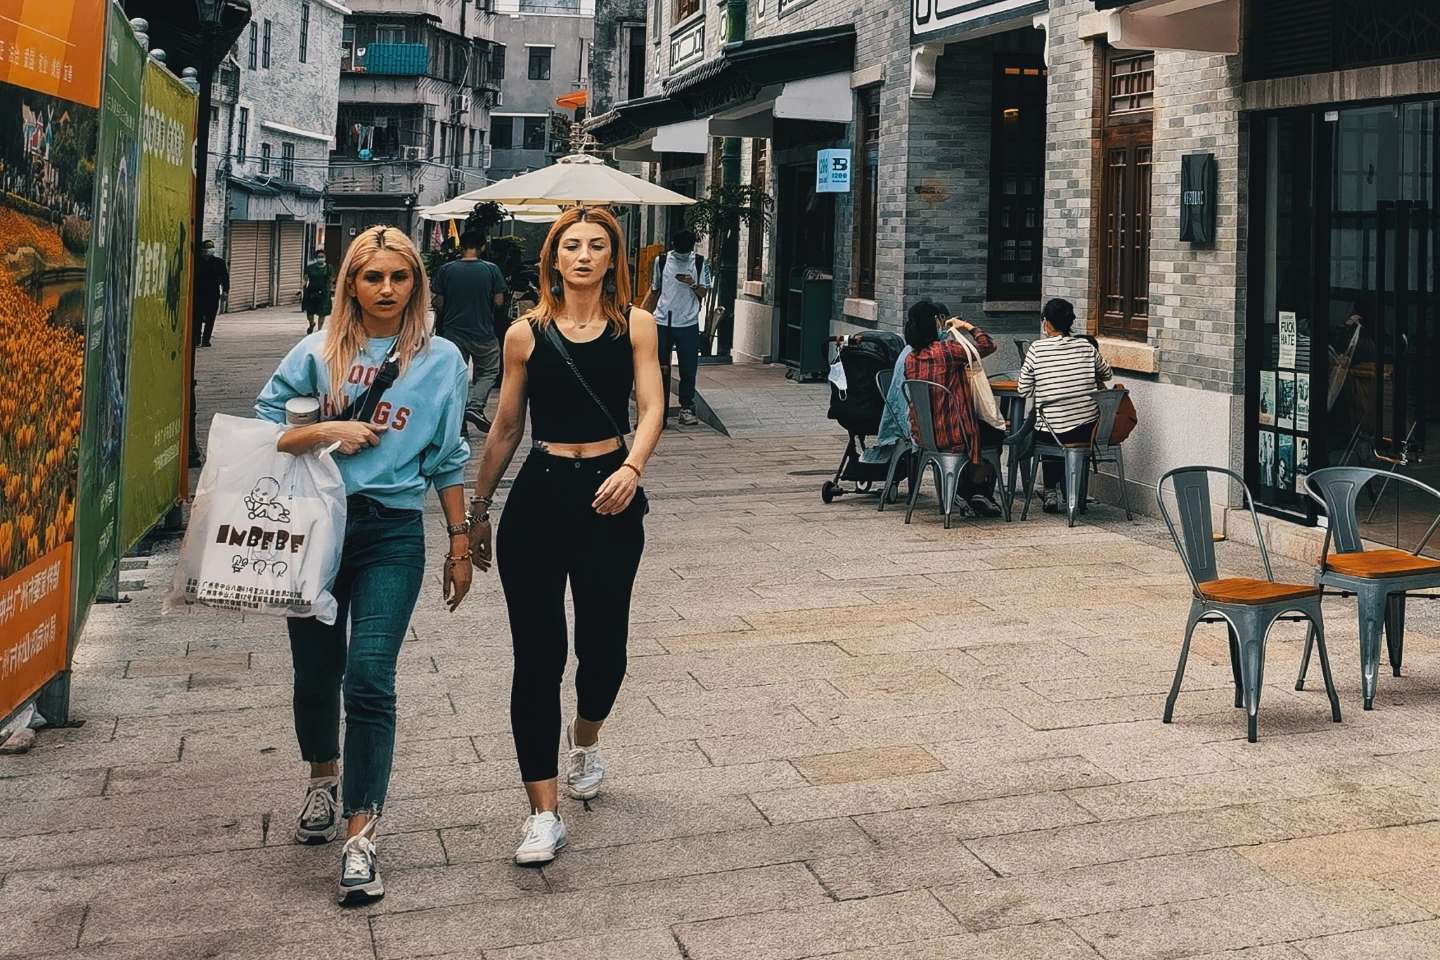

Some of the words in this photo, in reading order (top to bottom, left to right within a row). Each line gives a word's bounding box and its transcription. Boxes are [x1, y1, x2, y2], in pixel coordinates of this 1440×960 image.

[1280, 321, 1295, 333] FUCK
[1280, 334, 1295, 346] HATE
[216, 524, 305, 553] INBEBE
